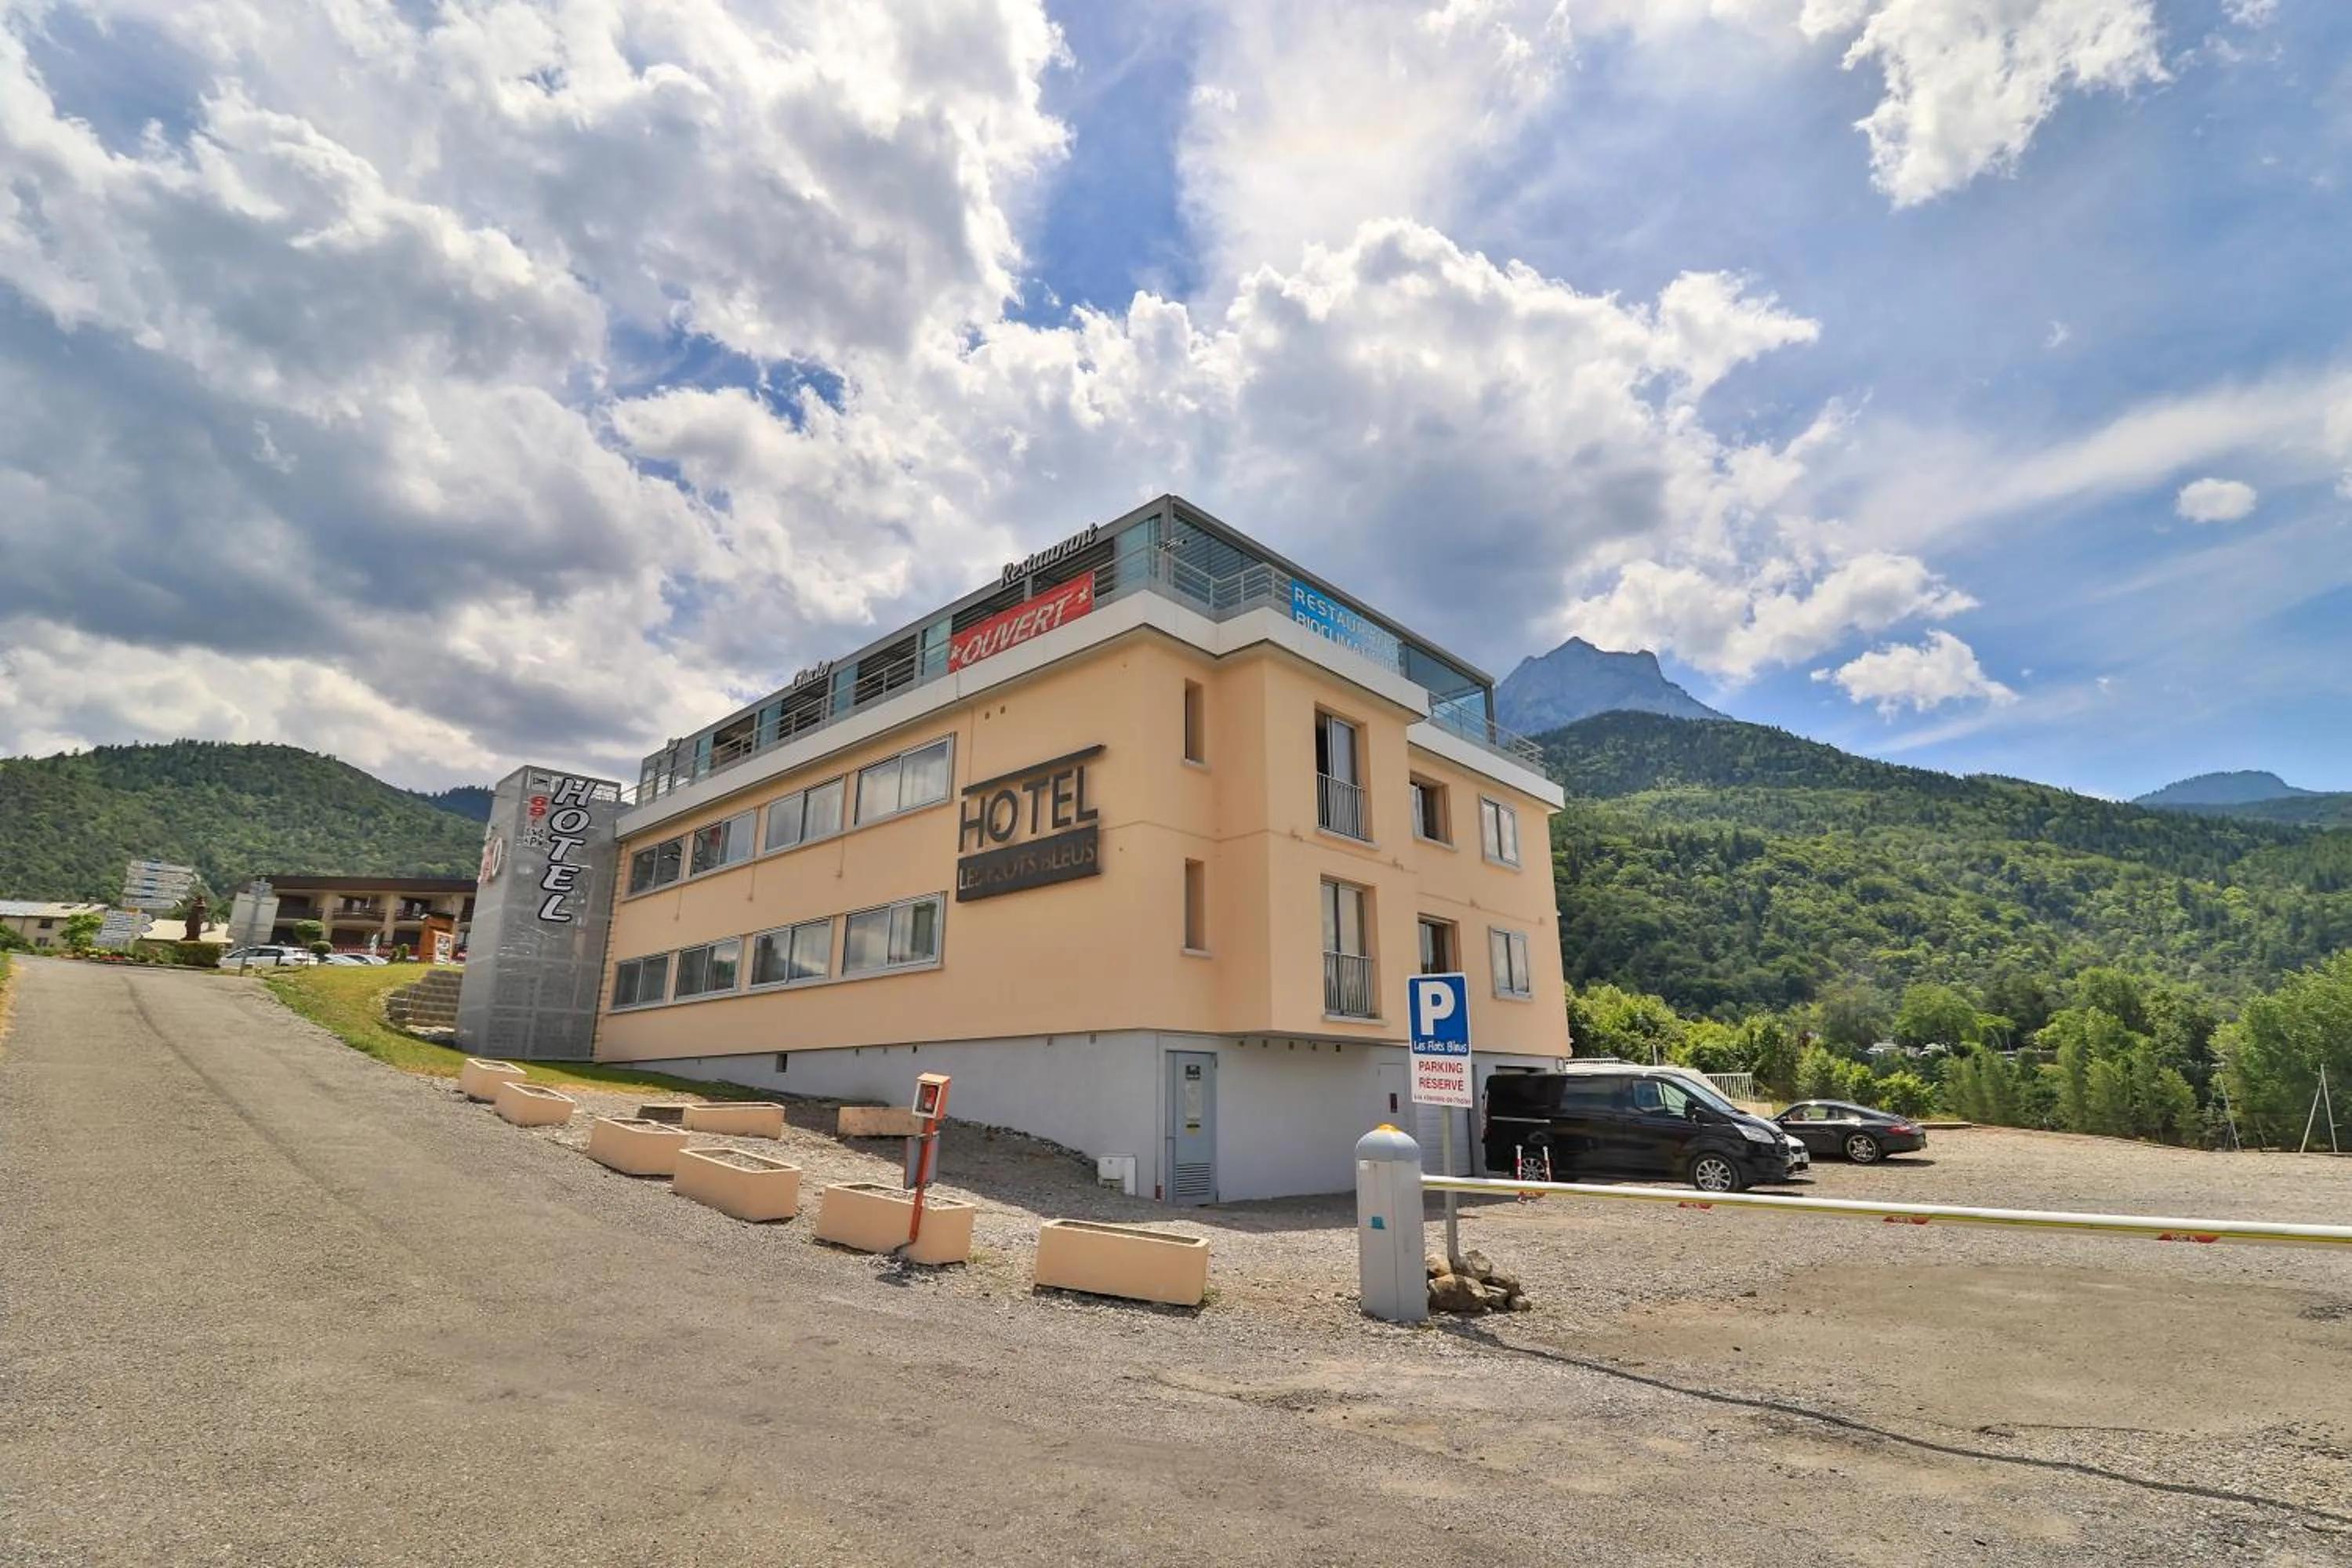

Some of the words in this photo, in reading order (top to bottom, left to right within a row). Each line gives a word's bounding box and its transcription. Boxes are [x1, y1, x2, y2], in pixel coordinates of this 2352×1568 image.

[1000, 523, 1098, 587] Restaurant
[960, 593, 1073, 665] OUVERT
[959, 765, 1098, 853] HOTEL
[538, 777, 597, 922] HOTEL
[1419, 982, 1455, 1035] P
[1418, 1061, 1463, 1073] PARKING
